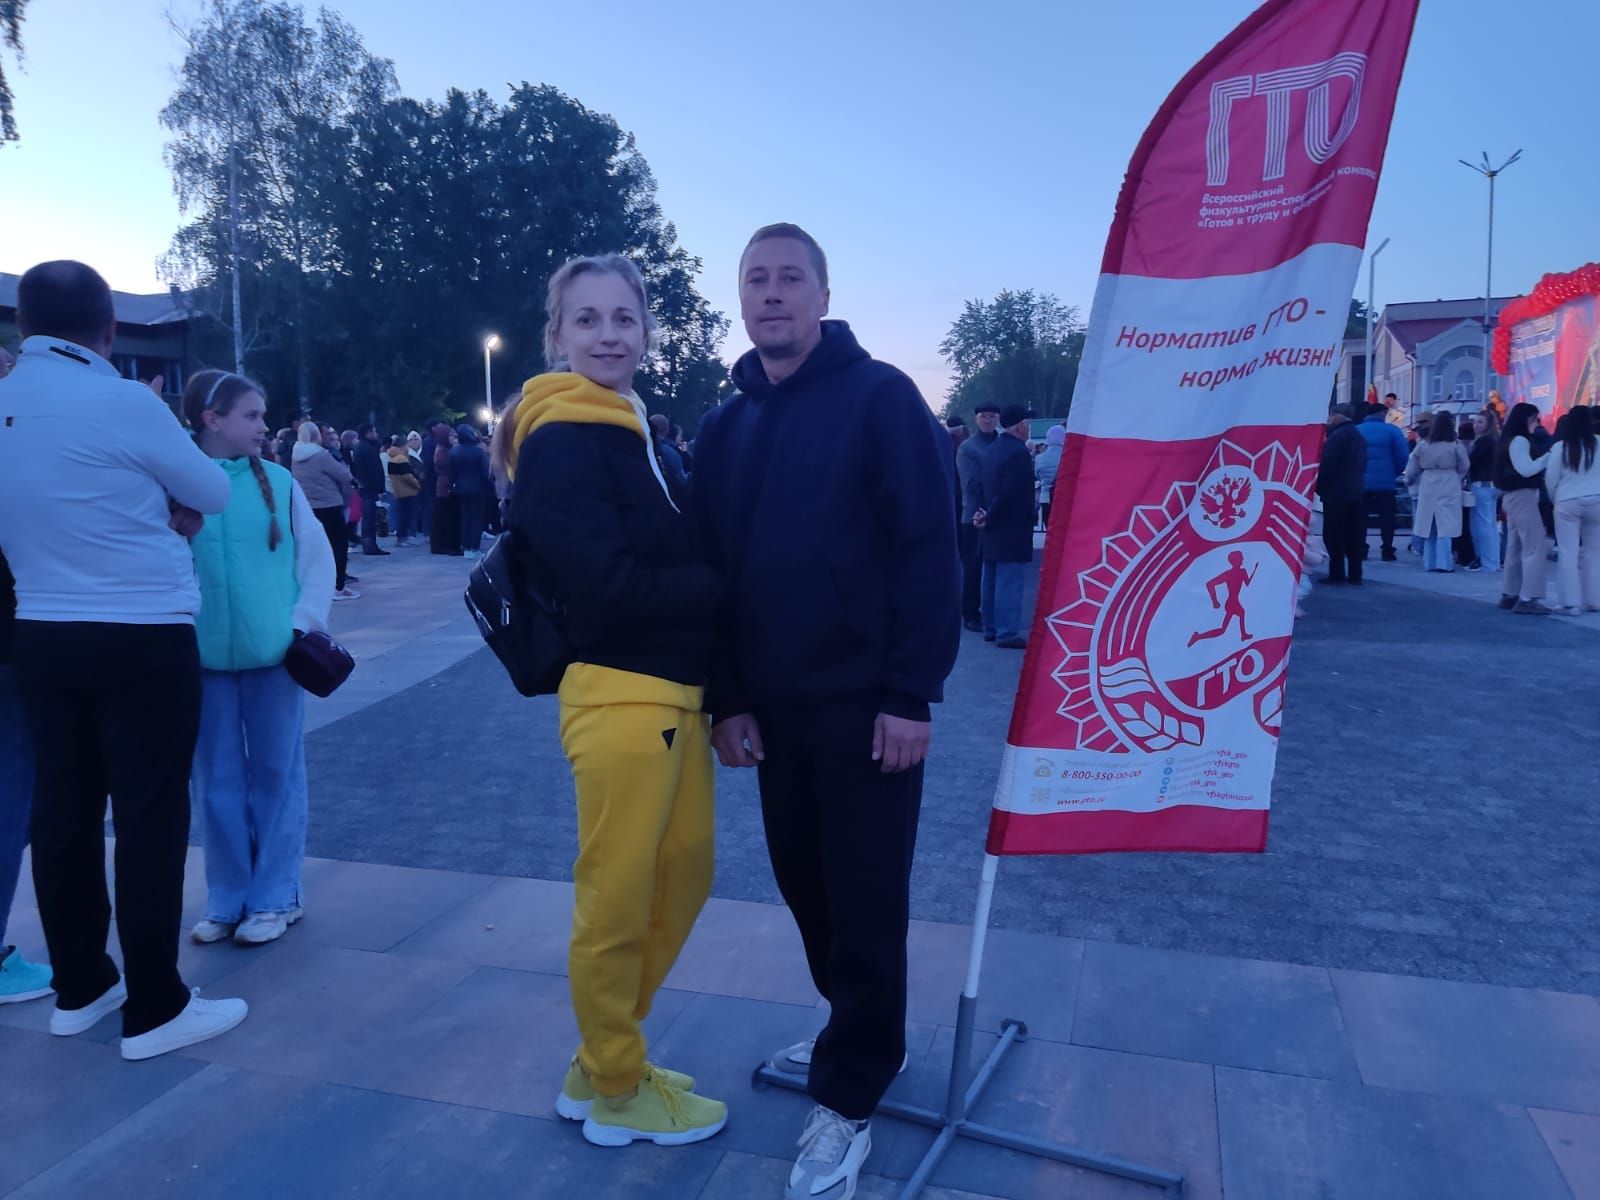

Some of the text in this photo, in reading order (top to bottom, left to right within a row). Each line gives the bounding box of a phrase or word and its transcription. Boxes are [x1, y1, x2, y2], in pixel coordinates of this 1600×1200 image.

[1206, 51, 1368, 186] ГТО
[1202, 184, 1284, 205] Всероссийский
[1237, 217, 1244, 225] к
[1247, 210, 1280, 225] труду
[1282, 208, 1290, 217] и
[1115, 324, 1257, 353] Норматив
[1262, 297, 1309, 336] ГТО
[1178, 358, 1258, 391] норма
[1196, 648, 1265, 707] ГТО
[1061, 769, 1142, 781] 8-800-350-00-00
